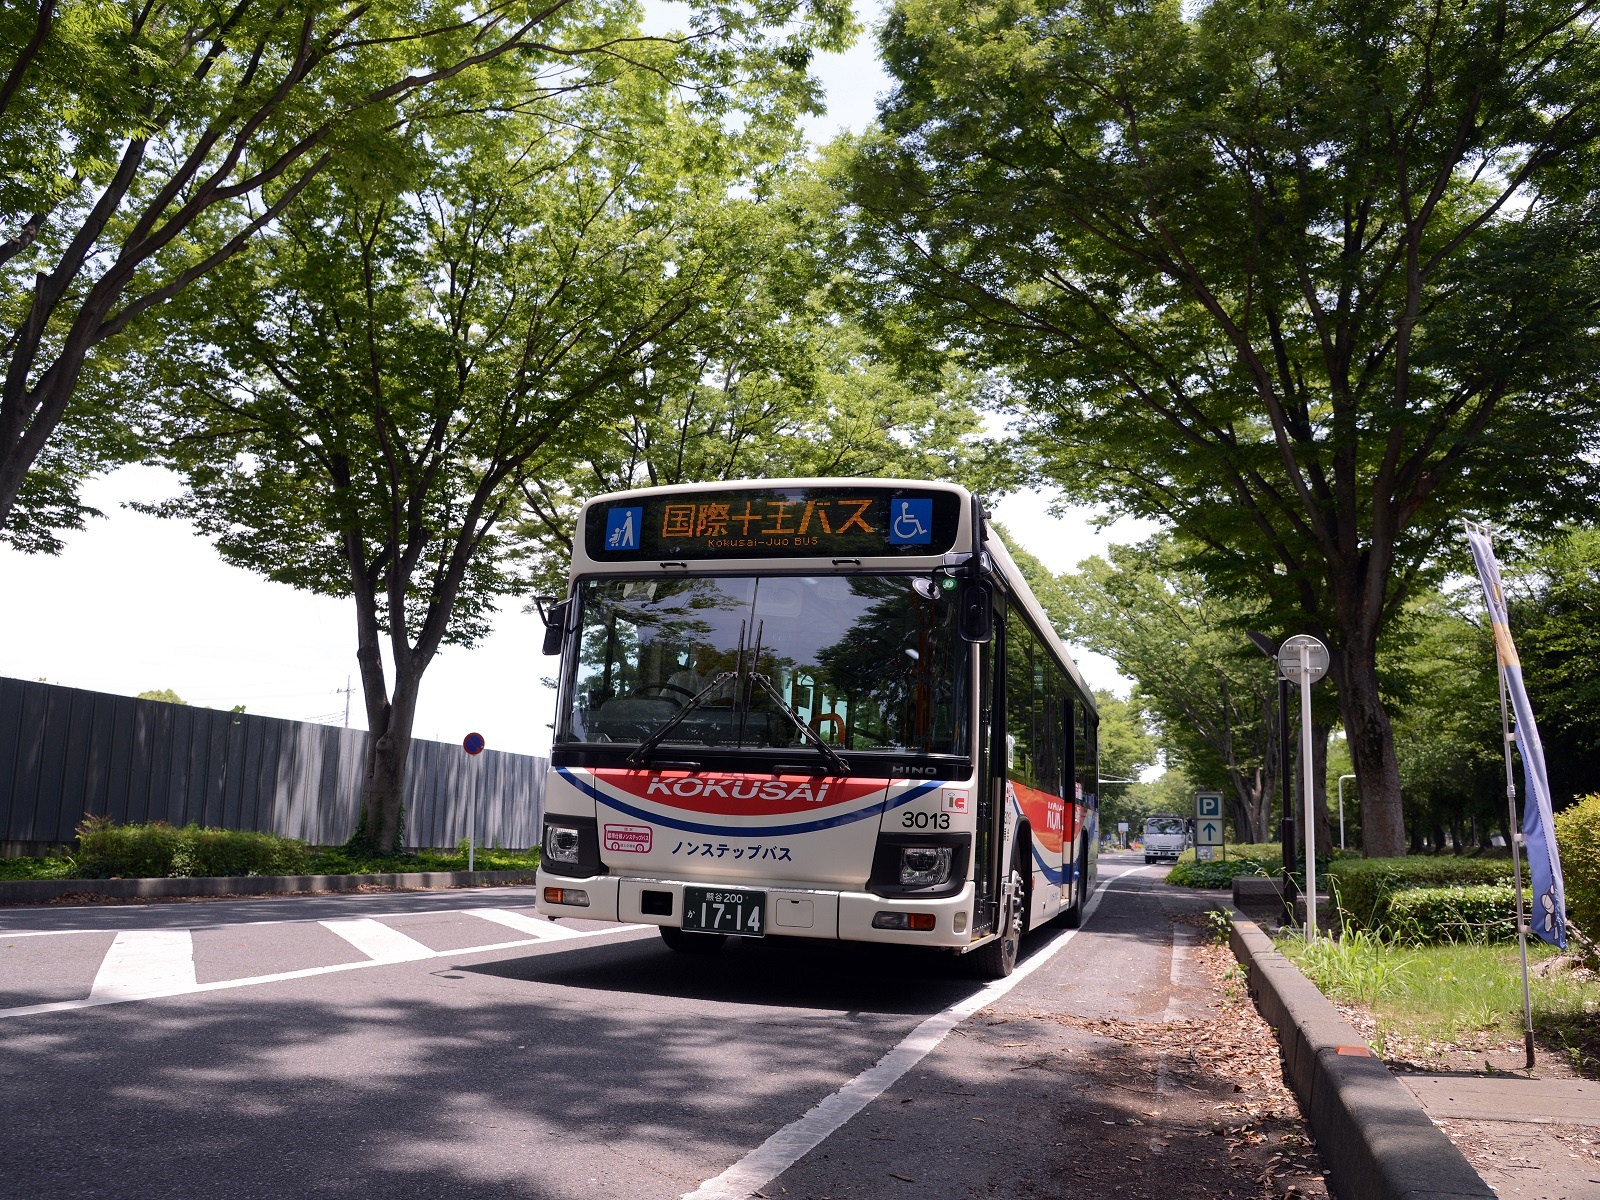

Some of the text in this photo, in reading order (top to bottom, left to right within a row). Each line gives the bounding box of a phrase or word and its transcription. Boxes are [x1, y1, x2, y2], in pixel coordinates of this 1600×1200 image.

[662, 500, 875, 537] 国際十王バス
[708, 537, 818, 547] Kokusai-Juo BUS
[892, 766, 937, 775] HINO
[646, 777, 830, 802] KOKUSAI
[1202, 799, 1215, 814] P
[902, 811, 950, 830] 3013
[672, 841, 792, 862] ノンステップバス
[687, 902, 760, 932] か 17-14
